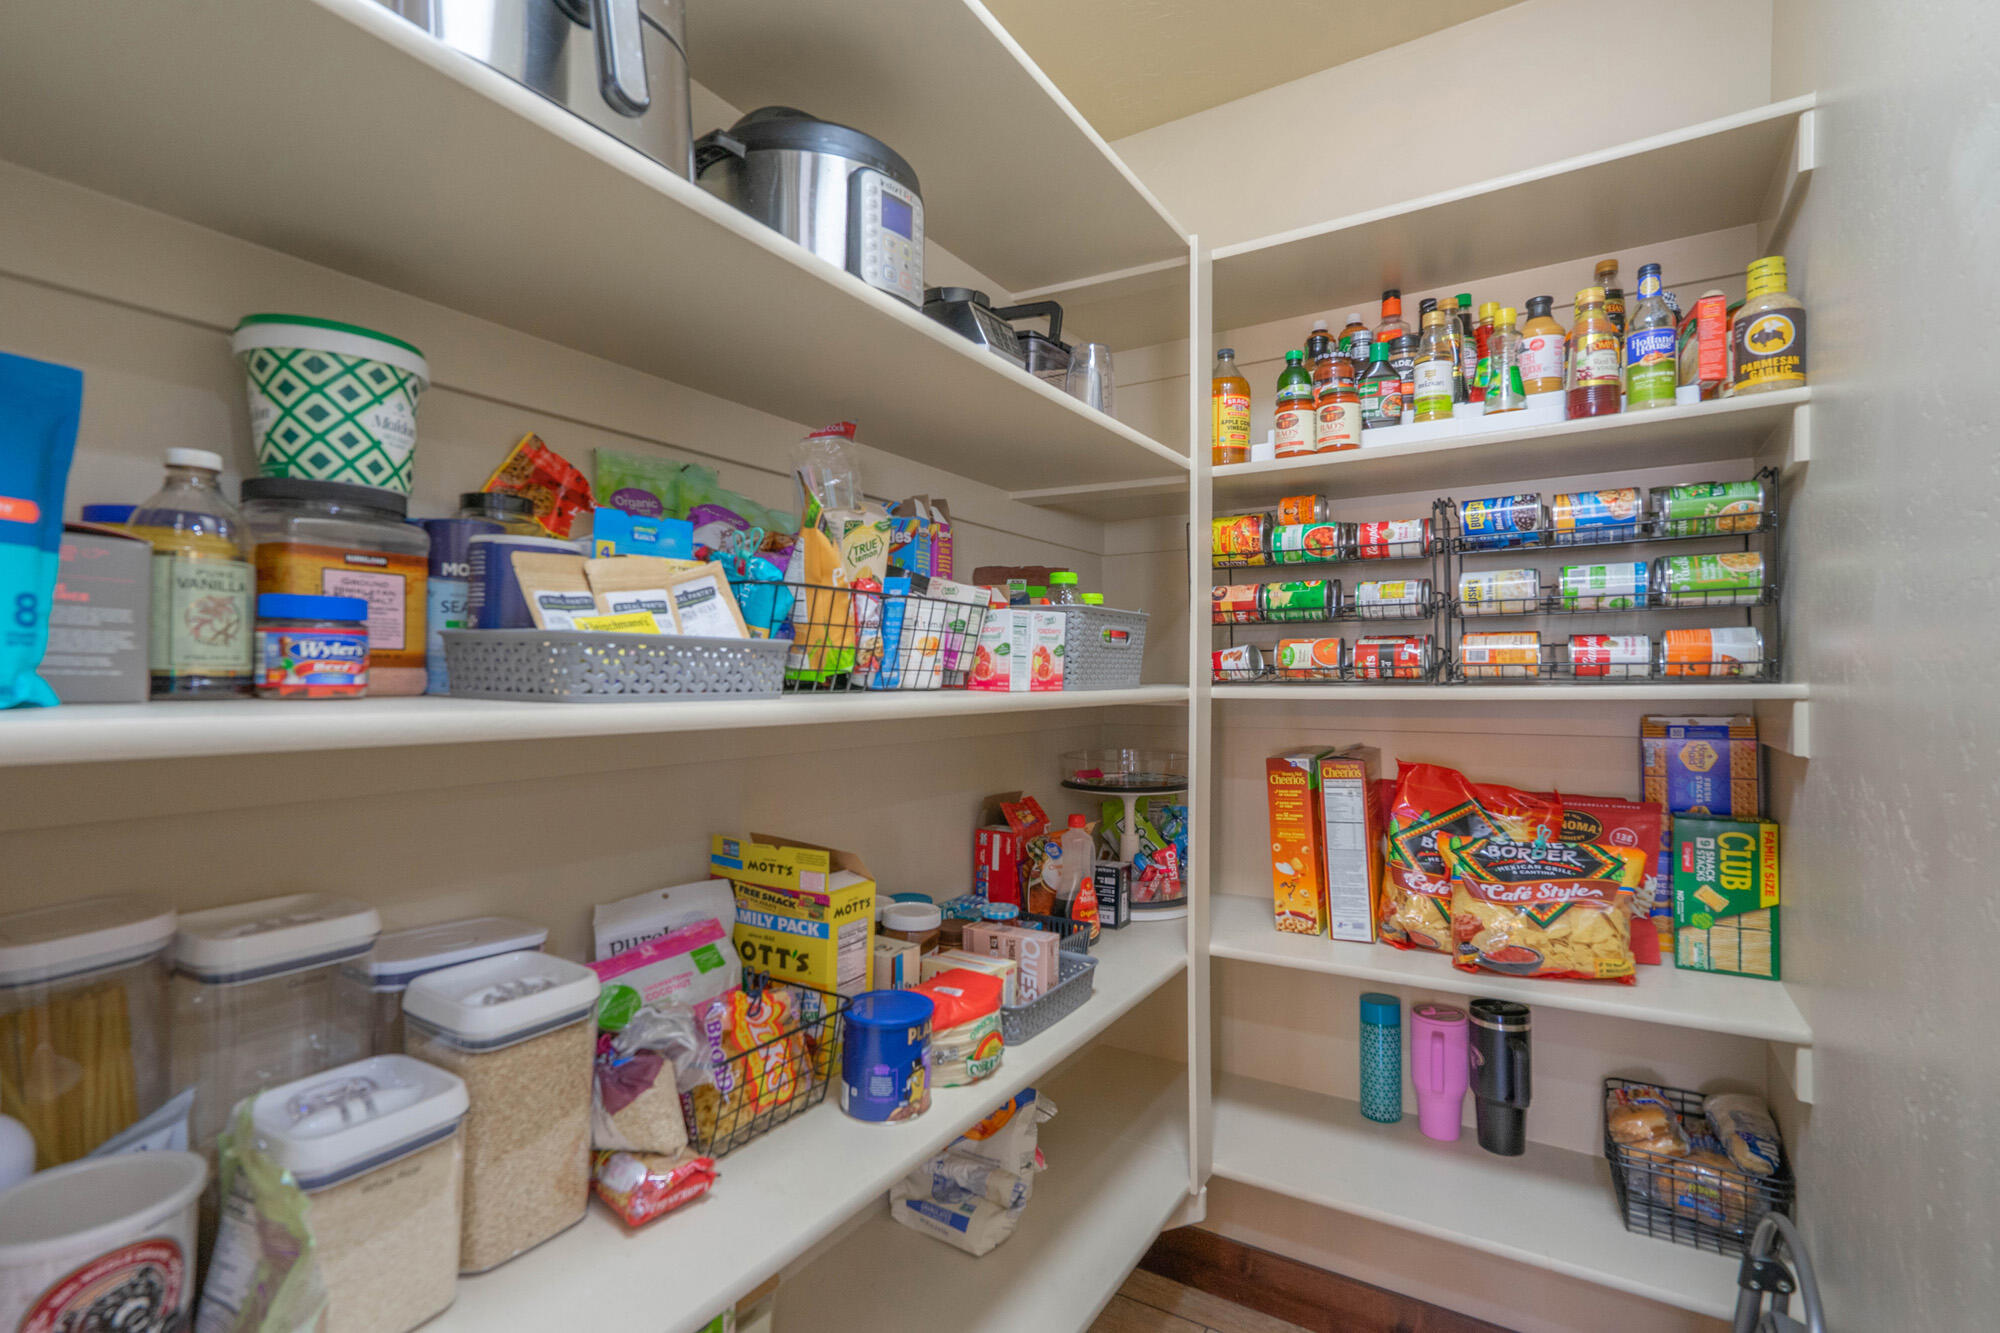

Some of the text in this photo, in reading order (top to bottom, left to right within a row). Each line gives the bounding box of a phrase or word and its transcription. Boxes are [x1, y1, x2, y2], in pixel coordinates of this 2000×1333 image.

[1632, 335, 1675, 350] Holland
[1636, 343, 1672, 357] House
[1740, 355, 1800, 374] PARMESAN
[1749, 365, 1793, 380] GARLIC
[614, 494, 660, 510] Organic
[600, 546, 611, 558] 4
[853, 538, 878, 556] TRUE
[14, 592, 38, 628] 8
[299, 640, 364, 659] Wyler's
[1270, 774, 1306, 785] Cheerios
[1323, 767, 1362, 778] Cheerios
[1562, 820, 1597, 834] NOMA
[1165, 850, 1179, 881] QUEST
[1486, 845, 1586, 868] BORDER
[1695, 849, 1706, 882] STACKS
[1705, 850, 1716, 883] SNACK
[1716, 831, 1757, 891] CLUB
[1764, 830, 1776, 898] FAMILY SIZE
[747, 859, 793, 876] MOTT'S
[1497, 864, 1542, 873] MEXICAN
[739, 886, 797, 910] FREE SNACK
[1479, 882, 1605, 903] Café Style
[833, 896, 871, 919] MOTT'S
[777, 916, 820, 938] PACK
[740, 940, 811, 973] OTT'S
[1021, 936, 1041, 1003] QUES
[644, 978, 693, 1003] COCONUT
